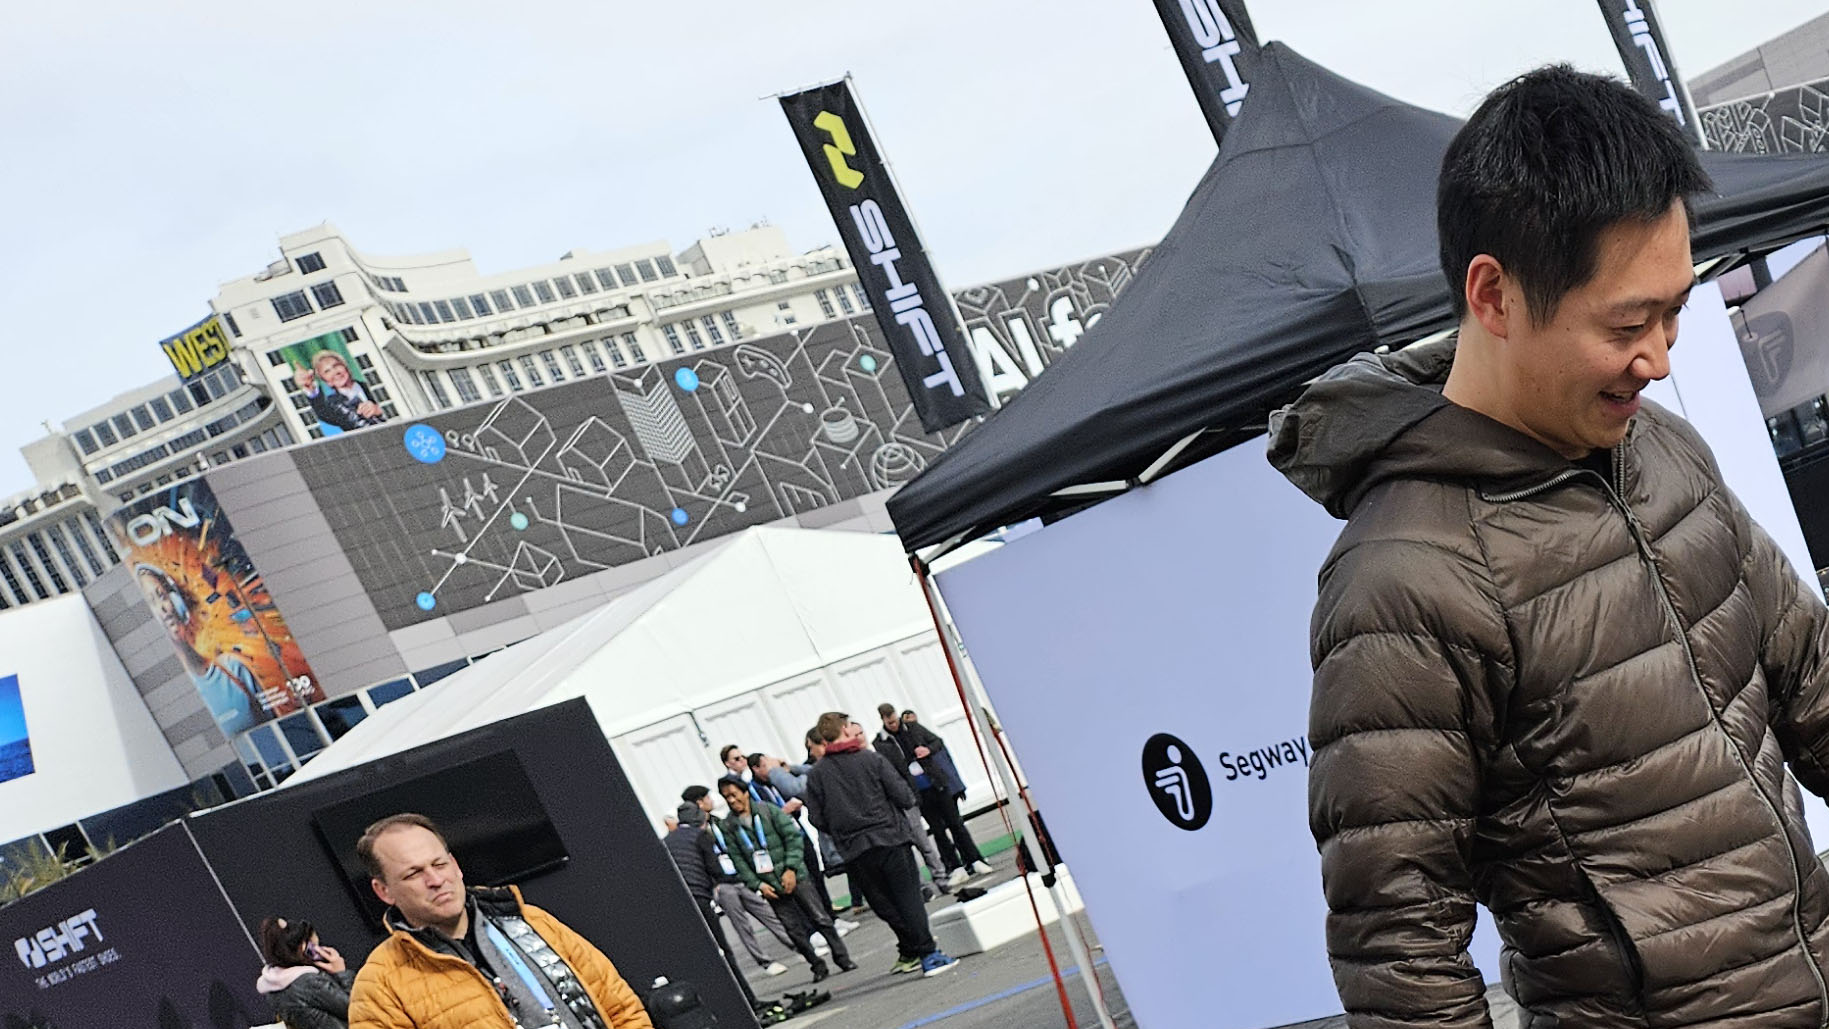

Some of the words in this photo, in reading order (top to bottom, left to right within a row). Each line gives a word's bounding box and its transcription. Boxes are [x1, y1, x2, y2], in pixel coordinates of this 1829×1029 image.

[1178, 0, 1250, 117] SH
[849, 199, 965, 398] SHIFT
[970, 316, 1045, 393] AI
[36, 908, 104, 963] SHIFT
